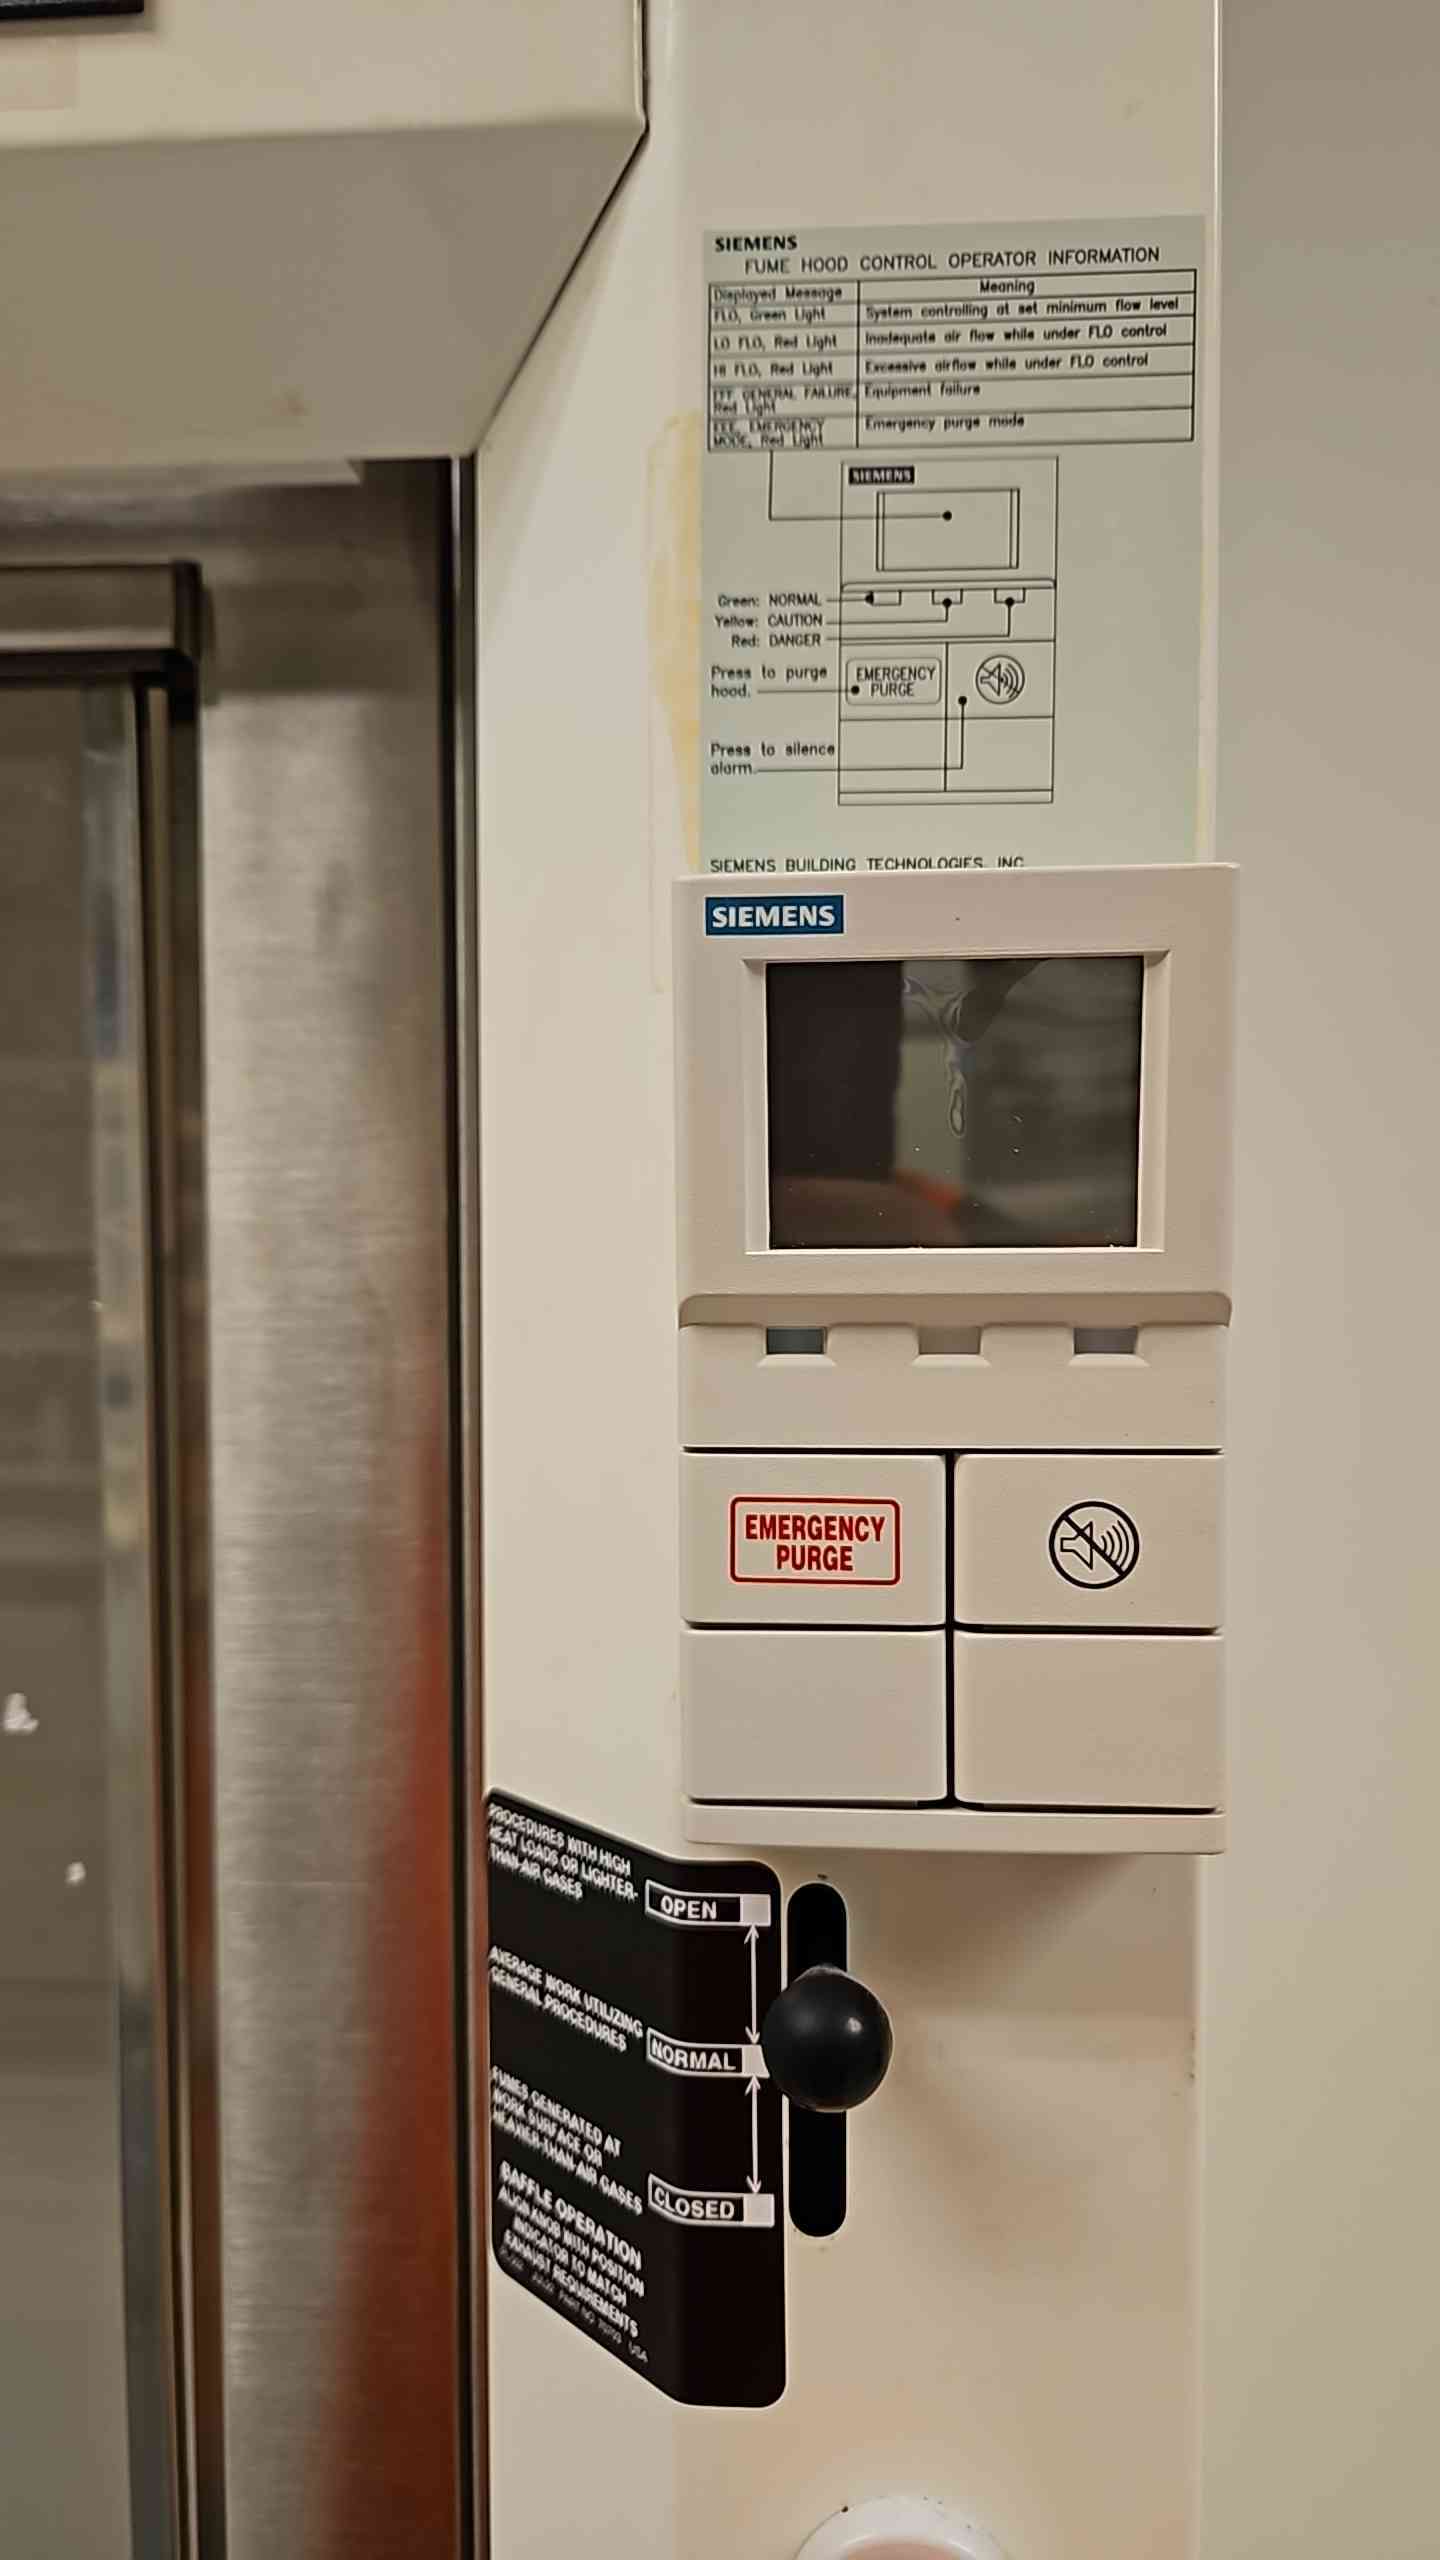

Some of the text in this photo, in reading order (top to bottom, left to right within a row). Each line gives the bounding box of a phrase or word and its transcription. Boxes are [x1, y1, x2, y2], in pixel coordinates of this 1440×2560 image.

[715, 235, 798, 252] SIEMENS
[745, 247, 1160, 275] FUME HOOD CONTROL OPERATOR INFORMATION
[714, 286, 842, 304] Displayed Message
[980, 280, 1035, 295] Meaning
[714, 307, 825, 325] FLO, Green Light
[865, 297, 1179, 322] System controlling at set minimum flow level
[738, 336, 766, 352] FLO,
[774, 335, 798, 349] Red
[806, 334, 837, 352] Light
[865, 322, 1167, 346] Inadequate air flow while under FLO control
[734, 363, 761, 377] FLO,
[770, 362, 794, 375] Red
[802, 361, 833, 377] Light
[865, 352, 1149, 375] Excessive airflow while under FLO control
[743, 386, 794, 401] GENERAL
[865, 381, 980, 399] Equipment failure
[714, 400, 776, 416] Red Light
[750, 418, 824, 433] EMERGENCY
[865, 412, 1024, 432] Emergency purge mode
[761, 433, 784, 447] Red
[792, 432, 824, 449] Light
[852, 468, 912, 482] SIEMENS
[718, 592, 822, 607] Green: NORMAL
[715, 612, 822, 628] Yellow: CAUTION
[731, 633, 821, 648] Red: DANGER
[711, 665, 828, 682] Press to purge
[856, 665, 936, 682] EMERGENCY
[711, 684, 751, 698] hood.
[871, 682, 915, 698] PURGE
[711, 740, 835, 757] Press to silence
[710, 858, 776, 873] SIEMENS
[786, 857, 856, 872] BUILDING
[712, 905, 835, 928] SIEMENS
[745, 1513, 886, 1543] EMERGENCY
[776, 1544, 853, 1572] PURGE
[489, 1803, 631, 1877] PROCEDURES WITH HIGH
[489, 1825, 518, 1847] HEAT
[521, 1836, 559, 1867] LOADS
[561, 1855, 578, 1876] OR
[543, 1868, 583, 1900] GASES
[660, 1895, 717, 1920] OPEN
[489, 1945, 643, 2038] AVERAGE WORK UTILIZING
[490, 1965, 627, 2052] GENERAL PROCEDURES
[652, 2038, 736, 2071] NORMAL
[492, 2065, 621, 2158] FUMES GENERATED AT
[493, 2088, 602, 2168] WORK SURFACE OR
[600, 2174, 643, 2216] GASES
[654, 2186, 735, 2219] CLOSED
[500, 2160, 552, 2211] BAFFLE
[555, 2198, 642, 2271] OPERATION
[513, 2215, 569, 2266] INDICATOR
[571, 2254, 586, 2278] TO
[587, 2266, 627, 2307] MATCH
[563, 2227, 590, 2259] WITH
[591, 2247, 645, 2298] POSITION
[504, 2229, 551, 2273] EXHAUST
[552, 2264, 638, 2338] REQUIREMENTS
